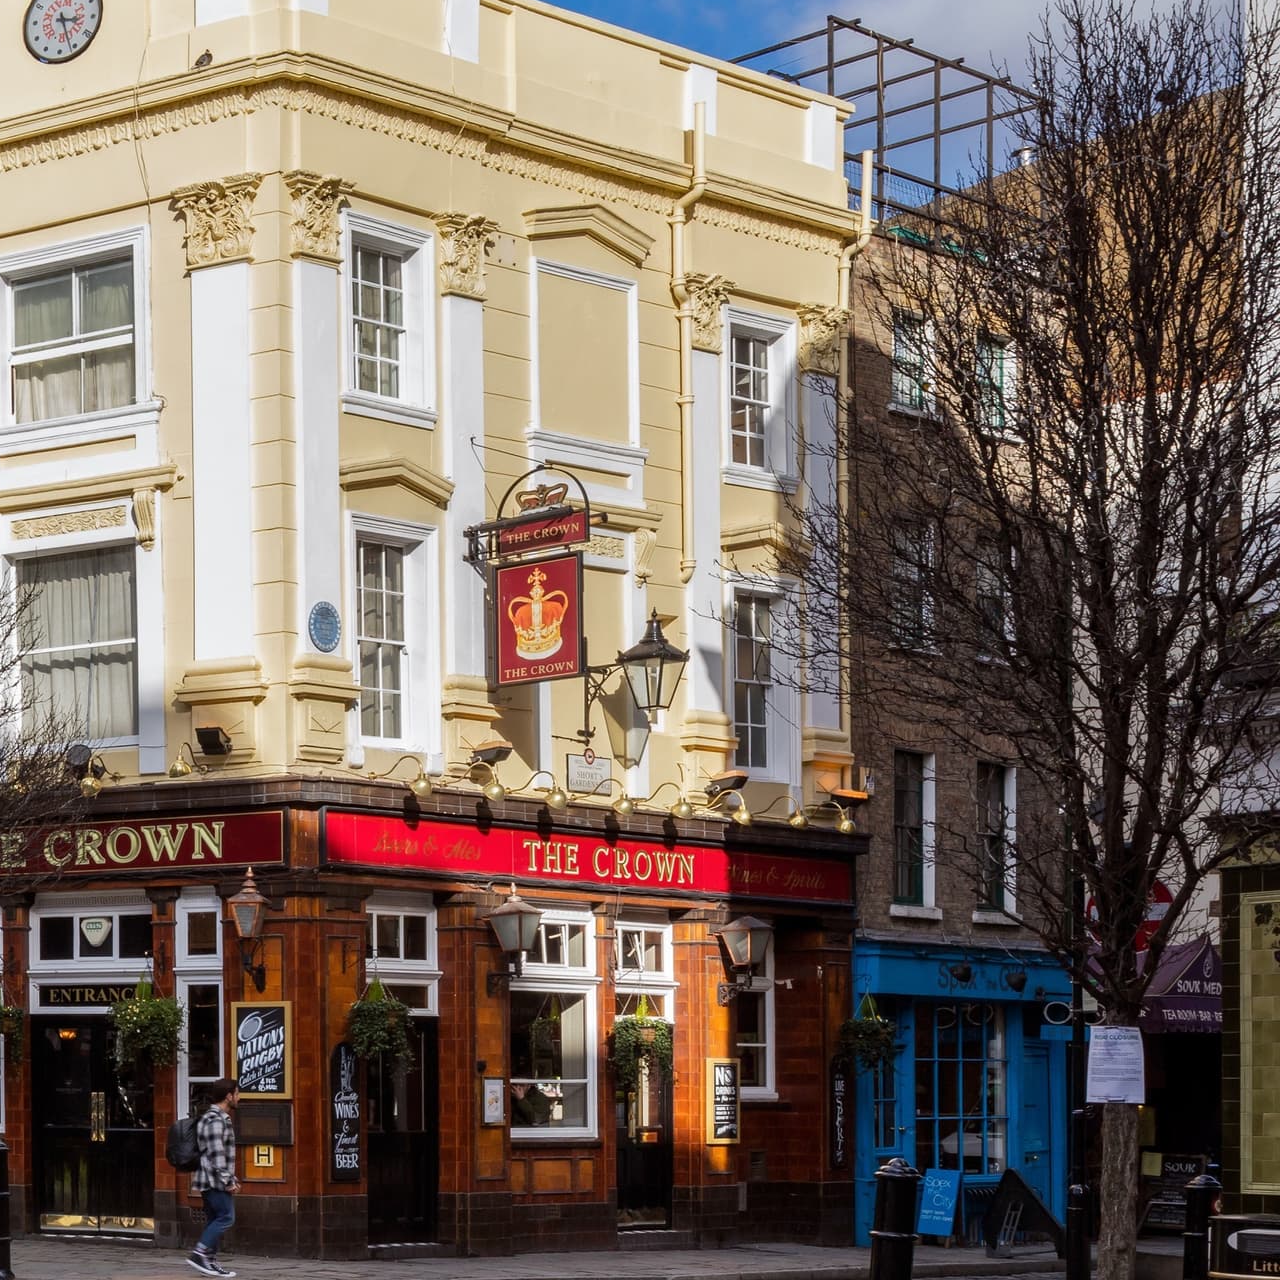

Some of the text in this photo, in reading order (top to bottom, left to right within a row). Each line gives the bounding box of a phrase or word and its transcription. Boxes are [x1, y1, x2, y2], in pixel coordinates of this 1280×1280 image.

[506, 522, 580, 545] THE CROWN
[504, 660, 575, 679] THE CROWN
[42, 821, 226, 867] CROWN
[523, 837, 696, 885] THE CROWN
[237, 1026, 284, 1061] NATIONS
[242, 1044, 284, 1074] RUGBY
[334, 1103, 359, 1119] WINES
[342, 1120, 349, 1133] &
[256, 1145, 270, 1164] H
[335, 1153, 359, 1168] BEER
